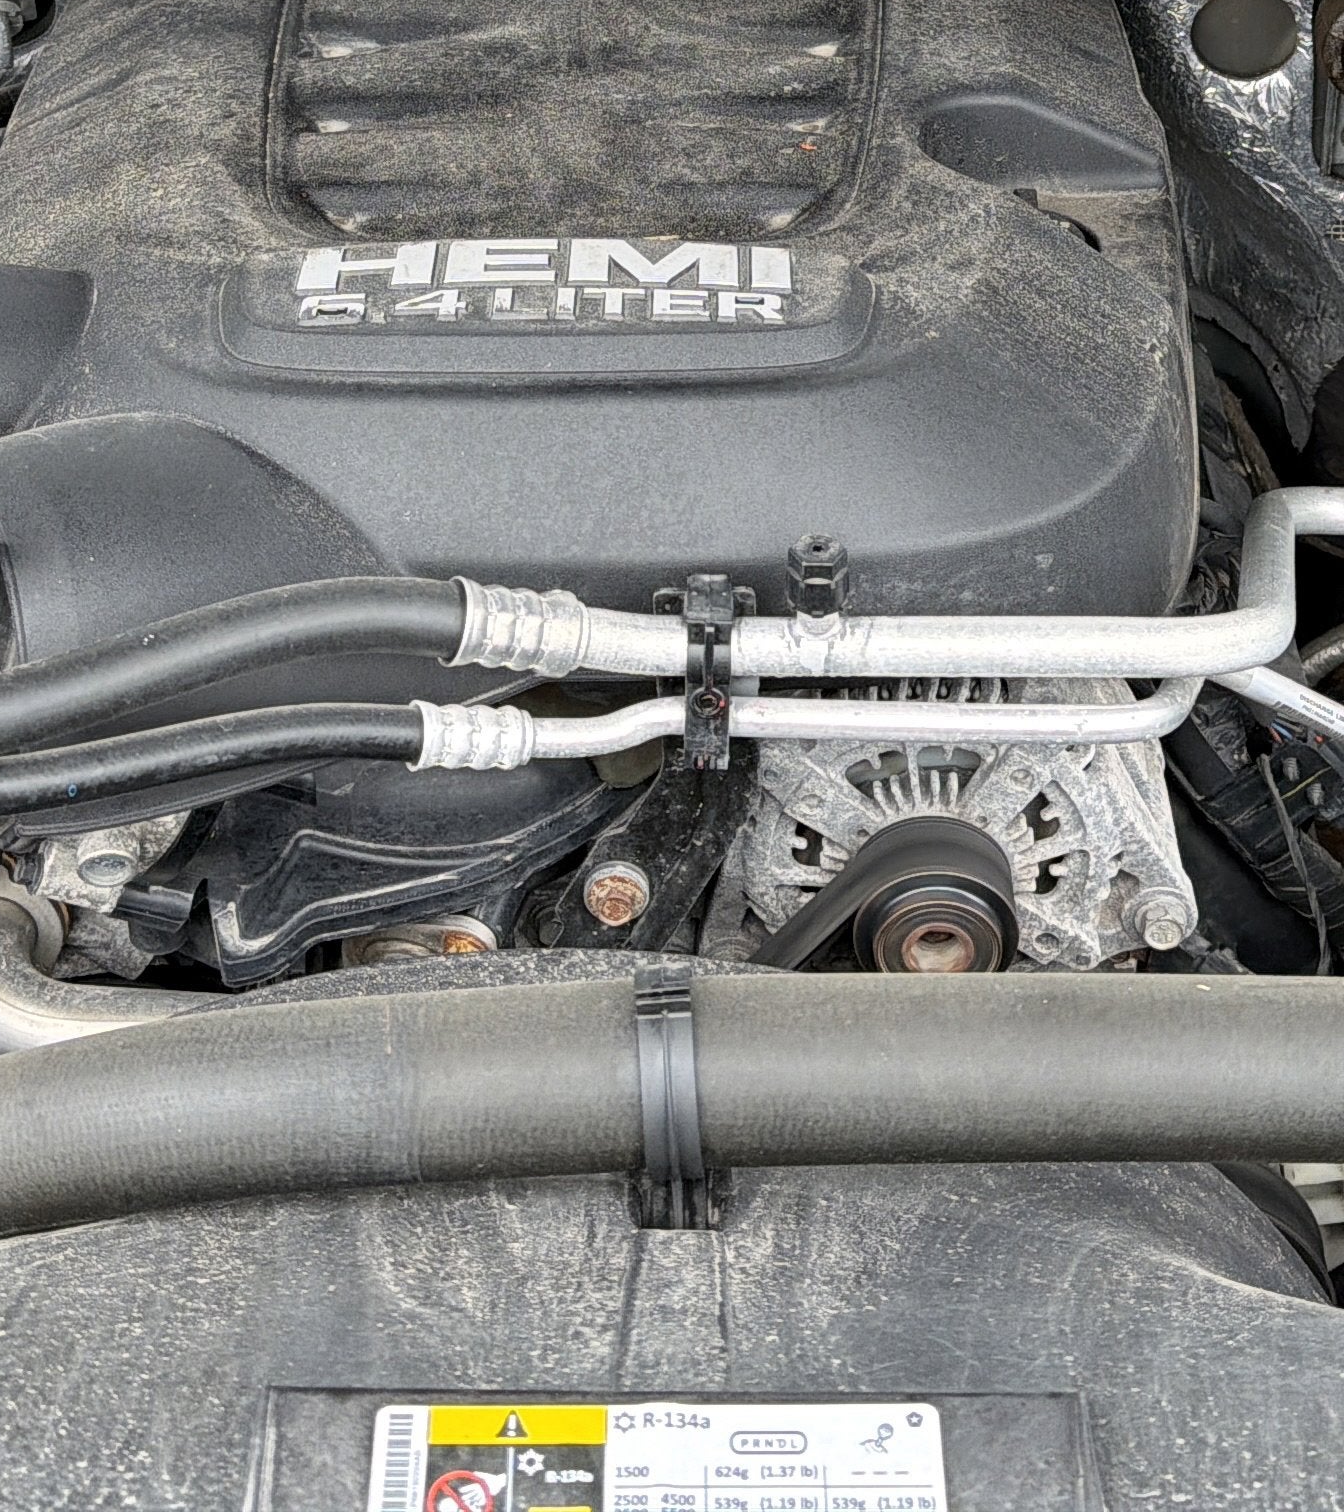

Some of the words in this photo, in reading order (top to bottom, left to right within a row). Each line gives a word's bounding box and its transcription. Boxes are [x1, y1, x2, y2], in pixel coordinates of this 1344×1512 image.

[295, 238, 792, 292] HEMI
[642, 1412, 711, 1429] R-134a
[614, 1466, 650, 1478] 1500
[714, 1466, 749, 1480] 624g
[760, 1465, 796, 1480] (1.37
[800, 1465, 819, 1479] lb)
[613, 1494, 649, 1506] 2500
[660, 1493, 696, 1506] 4500
[714, 1497, 749, 1511] 539g
[760, 1496, 796, 1512] (1.19
[800, 1496, 819, 1511] lb)
[832, 1497, 866, 1511] 539g
[877, 1496, 913, 1511] (1.19
[918, 1496, 937, 1511] lb)
